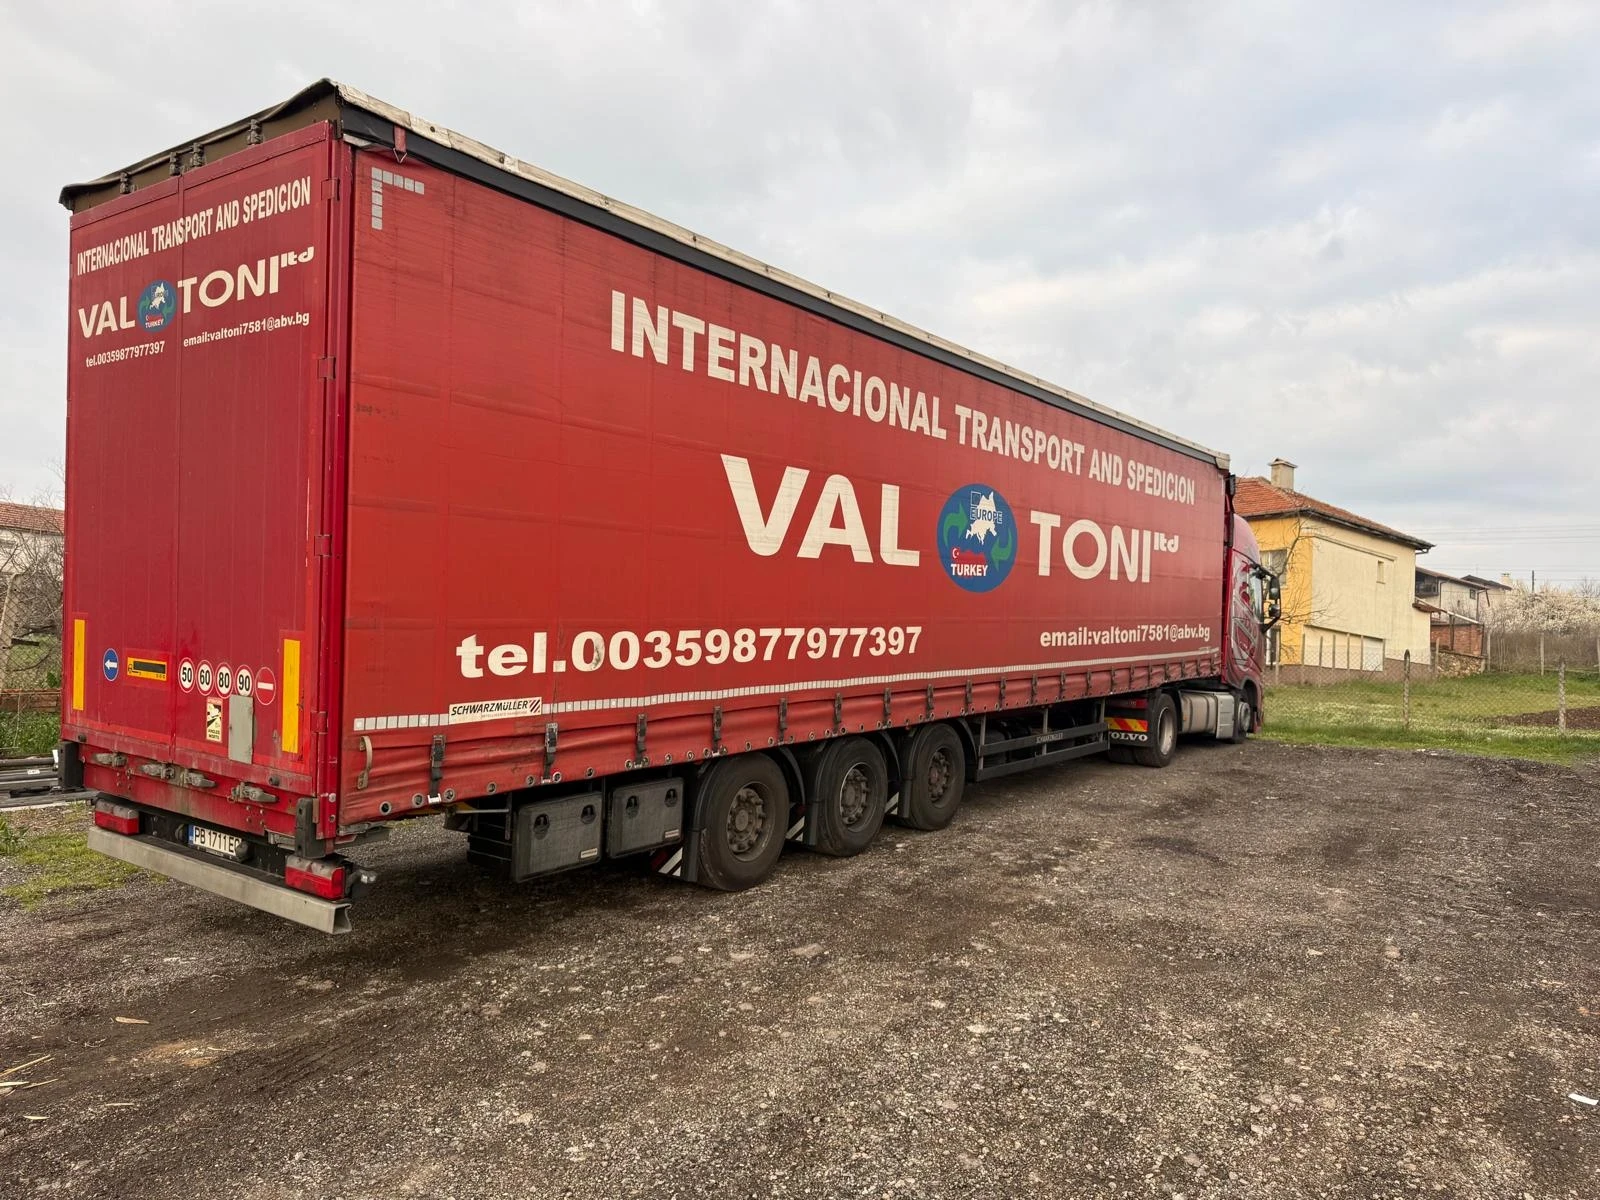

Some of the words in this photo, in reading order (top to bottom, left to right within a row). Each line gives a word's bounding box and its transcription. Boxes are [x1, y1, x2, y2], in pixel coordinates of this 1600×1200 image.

[77, 230, 149, 276] INTERNACIONAL
[152, 208, 213, 253] TRANSPORT
[215, 200, 239, 232] AND
[243, 176, 311, 224] SPEDICION
[78, 296, 135, 339] VAL
[177, 255, 279, 314] TONI
[280, 246, 315, 268] ltd
[183, 312, 310, 348] email:valtoni7581@abv.bg
[85, 340, 165, 368] tel.00359877977397
[611, 290, 947, 439] INTERNACIONAL
[955, 404, 1085, 477] TRANSPORT
[1088, 449, 1122, 487] AND
[1127, 460, 1195, 505] SPEDICION
[720, 453, 920, 568] VAL
[1030, 510, 1150, 583] TONI
[1153, 531, 1179, 554] ltd
[970, 506, 1003, 524] EUROPE
[950, 563, 988, 577] TURKEY
[1040, 623, 1211, 647] email:valtoni7581@abv.bg
[455, 626, 922, 679] tel.00359877977397
[181, 666, 192, 683] 50
[199, 668, 211, 686] 60
[218, 671, 230, 688] 80
[238, 674, 250, 692] 90
[451, 700, 529, 716] SCHWARZMÜLLER
[1108, 731, 1148, 742] OLVO
